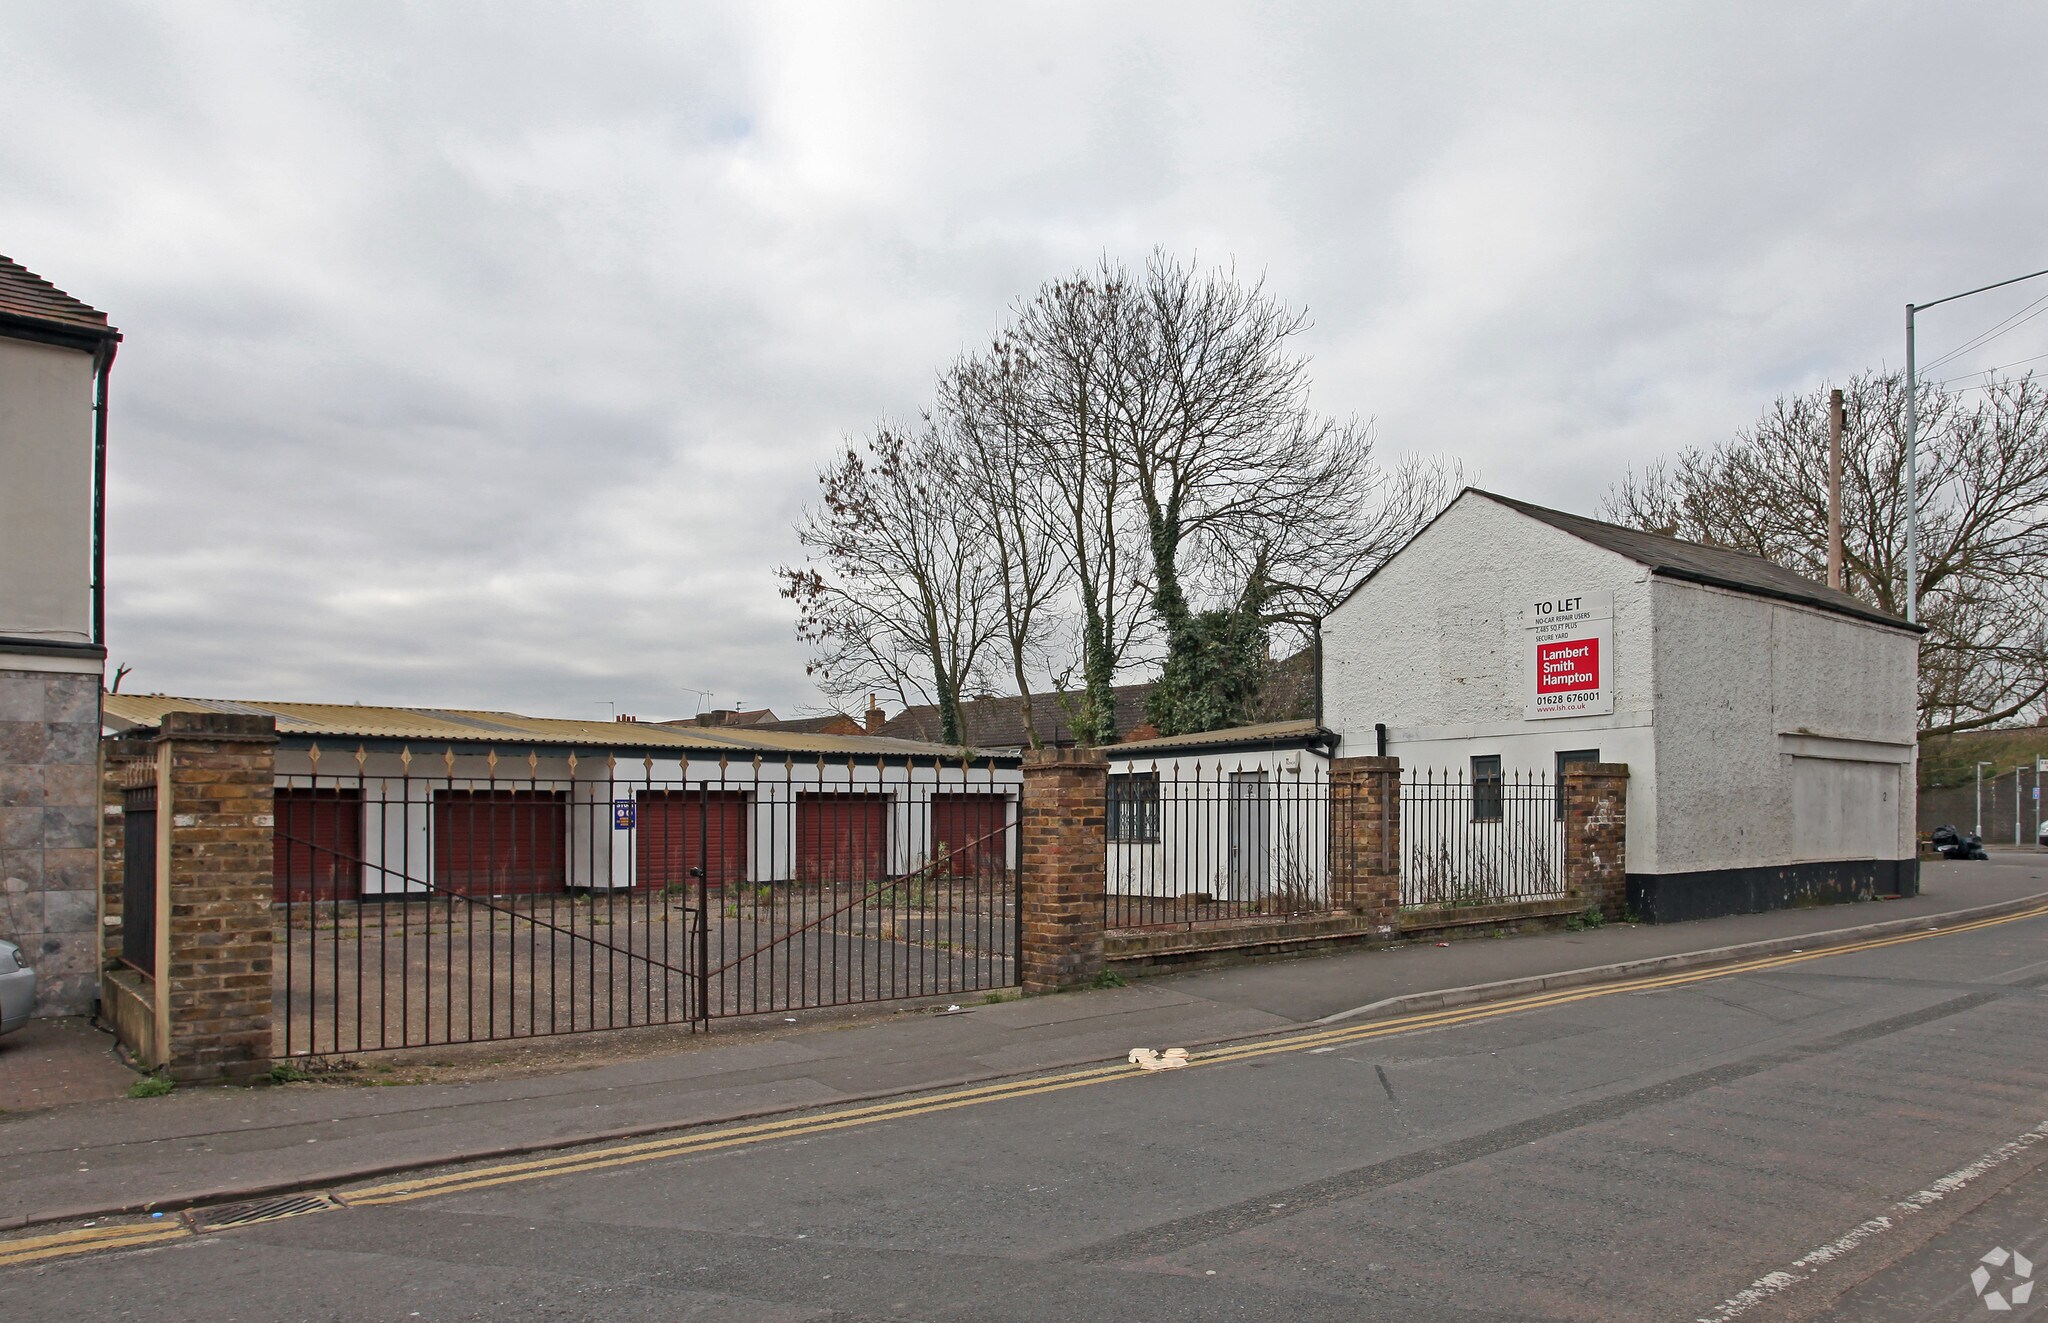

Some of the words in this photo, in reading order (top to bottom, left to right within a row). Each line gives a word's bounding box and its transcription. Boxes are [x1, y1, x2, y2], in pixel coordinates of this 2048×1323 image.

[1534, 602, 1552, 615] TO
[1558, 597, 1582, 612] LET
[1556, 614, 1573, 622] REPAIR
[1574, 612, 1591, 620] USERS
[1565, 622, 1578, 630] PLUS
[1535, 634, 1554, 642] SECURE
[1555, 632, 1569, 640] YARD
[1543, 646, 1589, 660] Lambert
[1543, 660, 1575, 673] Smith
[1543, 672, 1593, 685] Hampton
[1537, 696, 1563, 705] 01628
[1567, 692, 1599, 702] 676001
[1537, 704, 1586, 713] www.lsh.co.uk
